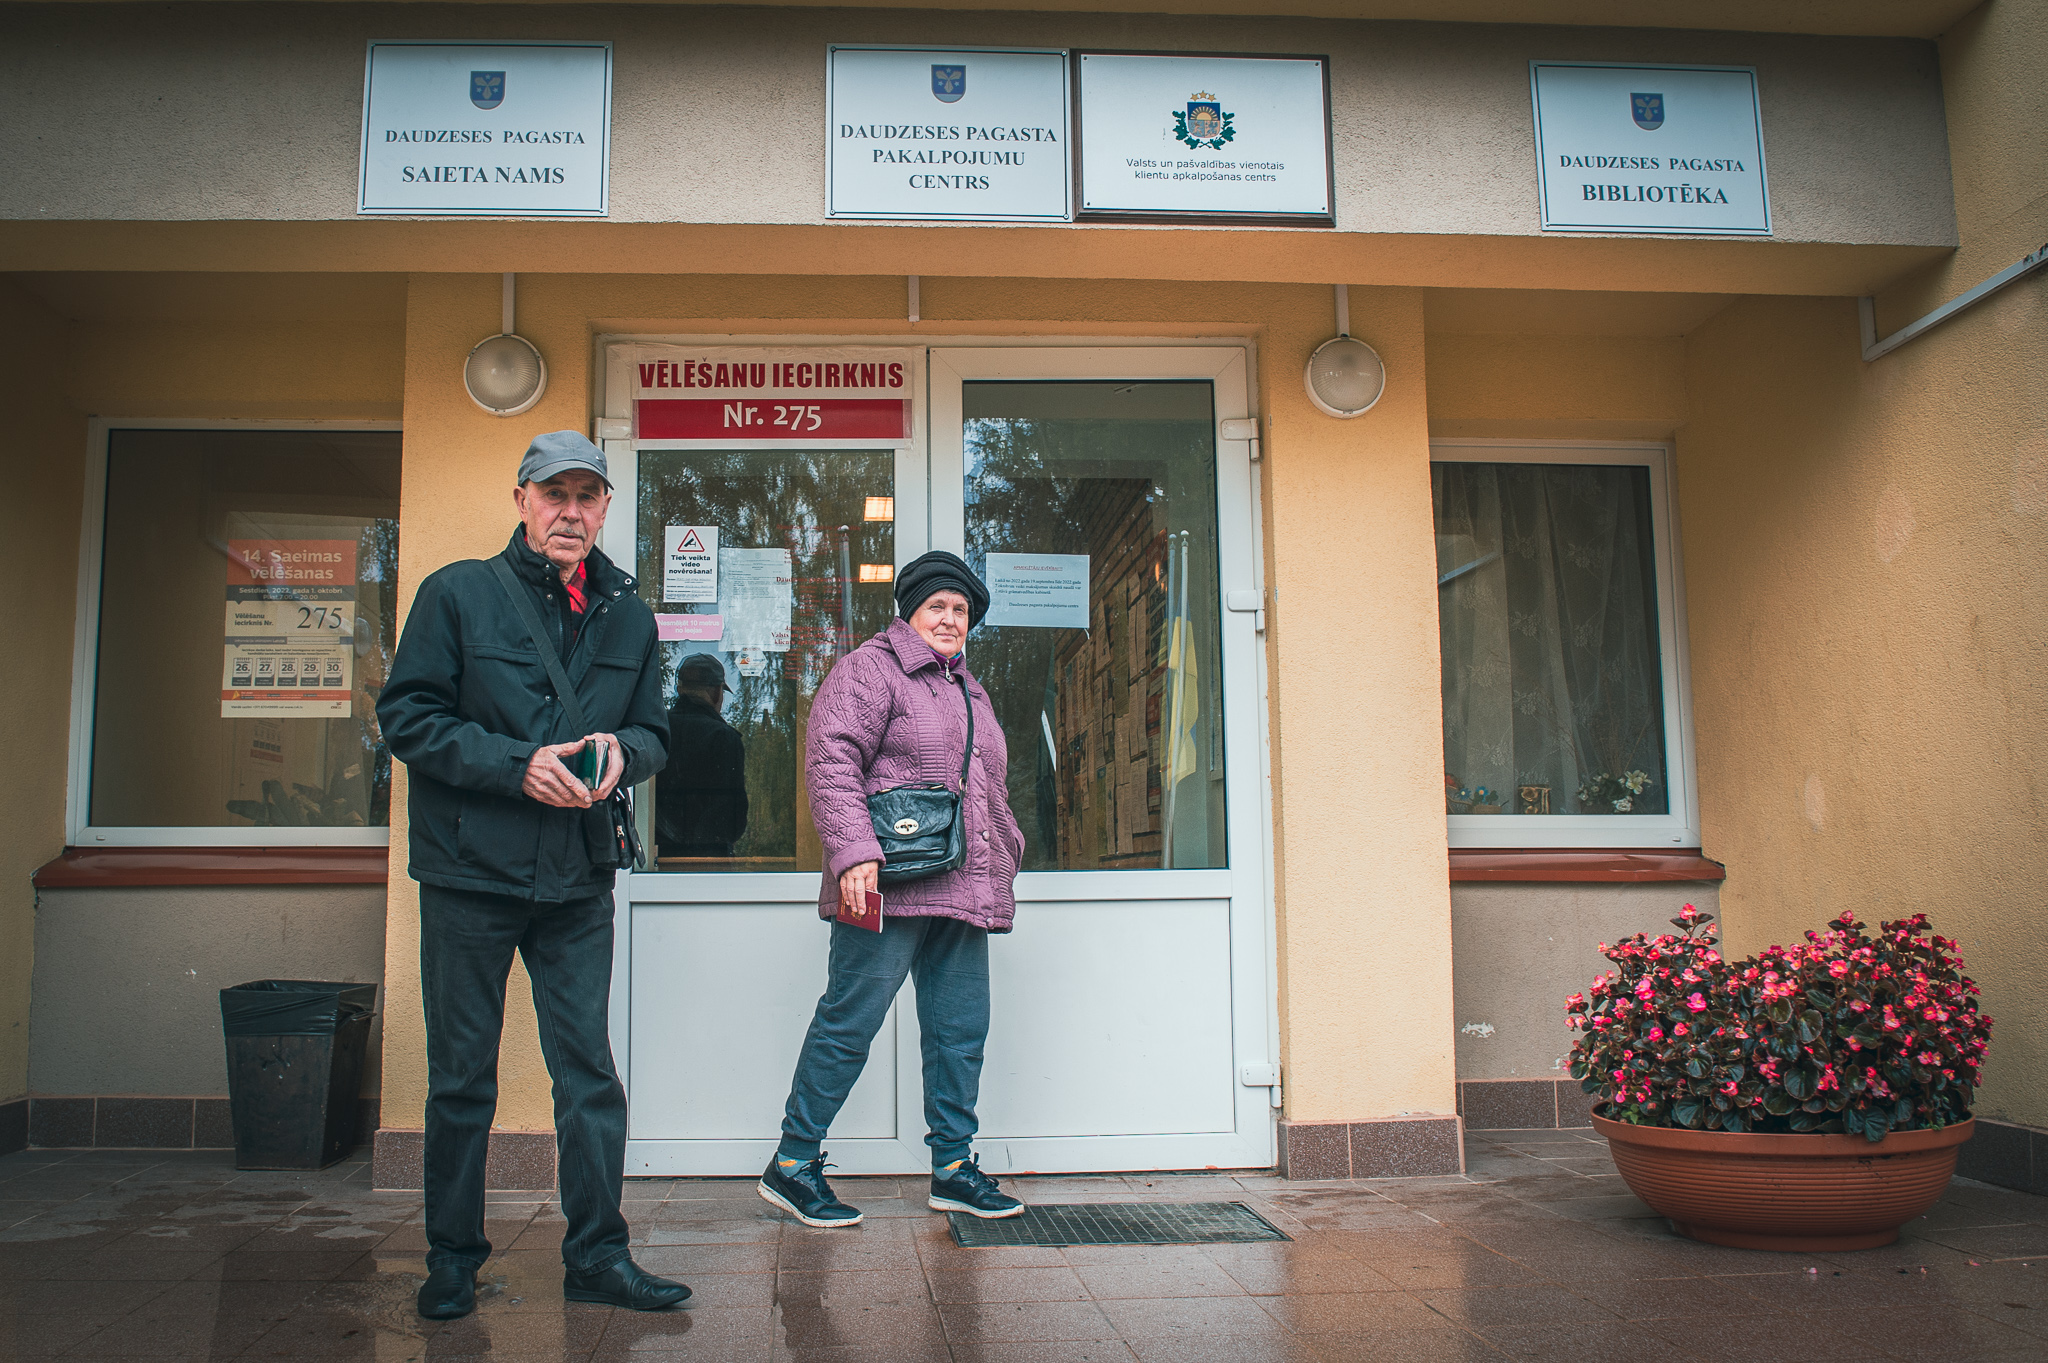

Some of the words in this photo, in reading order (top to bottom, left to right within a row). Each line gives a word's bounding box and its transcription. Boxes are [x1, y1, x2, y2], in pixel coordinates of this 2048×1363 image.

[385, 130, 492, 143] DAUDZESES
[503, 131, 586, 144] PAGASTA
[840, 124, 960, 140] DAUDZESES
[966, 126, 1057, 142] PAGASTA
[872, 149, 1026, 165] PAKALPOJUMU
[1126, 158, 1157, 168] Valsts
[1176, 159, 1236, 170] pašvaldības
[1239, 161, 1284, 170] vienotais
[1560, 155, 1660, 170] DAUDZESES
[1668, 158, 1744, 172] PAGASTA
[402, 166, 488, 183] SAIETA
[495, 167, 565, 184] NAMS
[909, 174, 990, 190] CENTRS
[1134, 170, 1169, 180] klientu
[1172, 171, 1242, 182] apkalpošanas
[1244, 173, 1276, 182] centrs
[1582, 184, 1729, 204] BIBLIOTĒKA
[638, 356, 765, 388] VĒLĒŠANU
[772, 362, 904, 388] IECIRKNIS
[724, 402, 764, 428] Nr.
[773, 405, 822, 431] 275
[243, 550, 265, 562] 14.
[270, 550, 342, 562] Saeimas
[250, 566, 333, 580] vēlēšanas
[297, 606, 342, 629] 275
